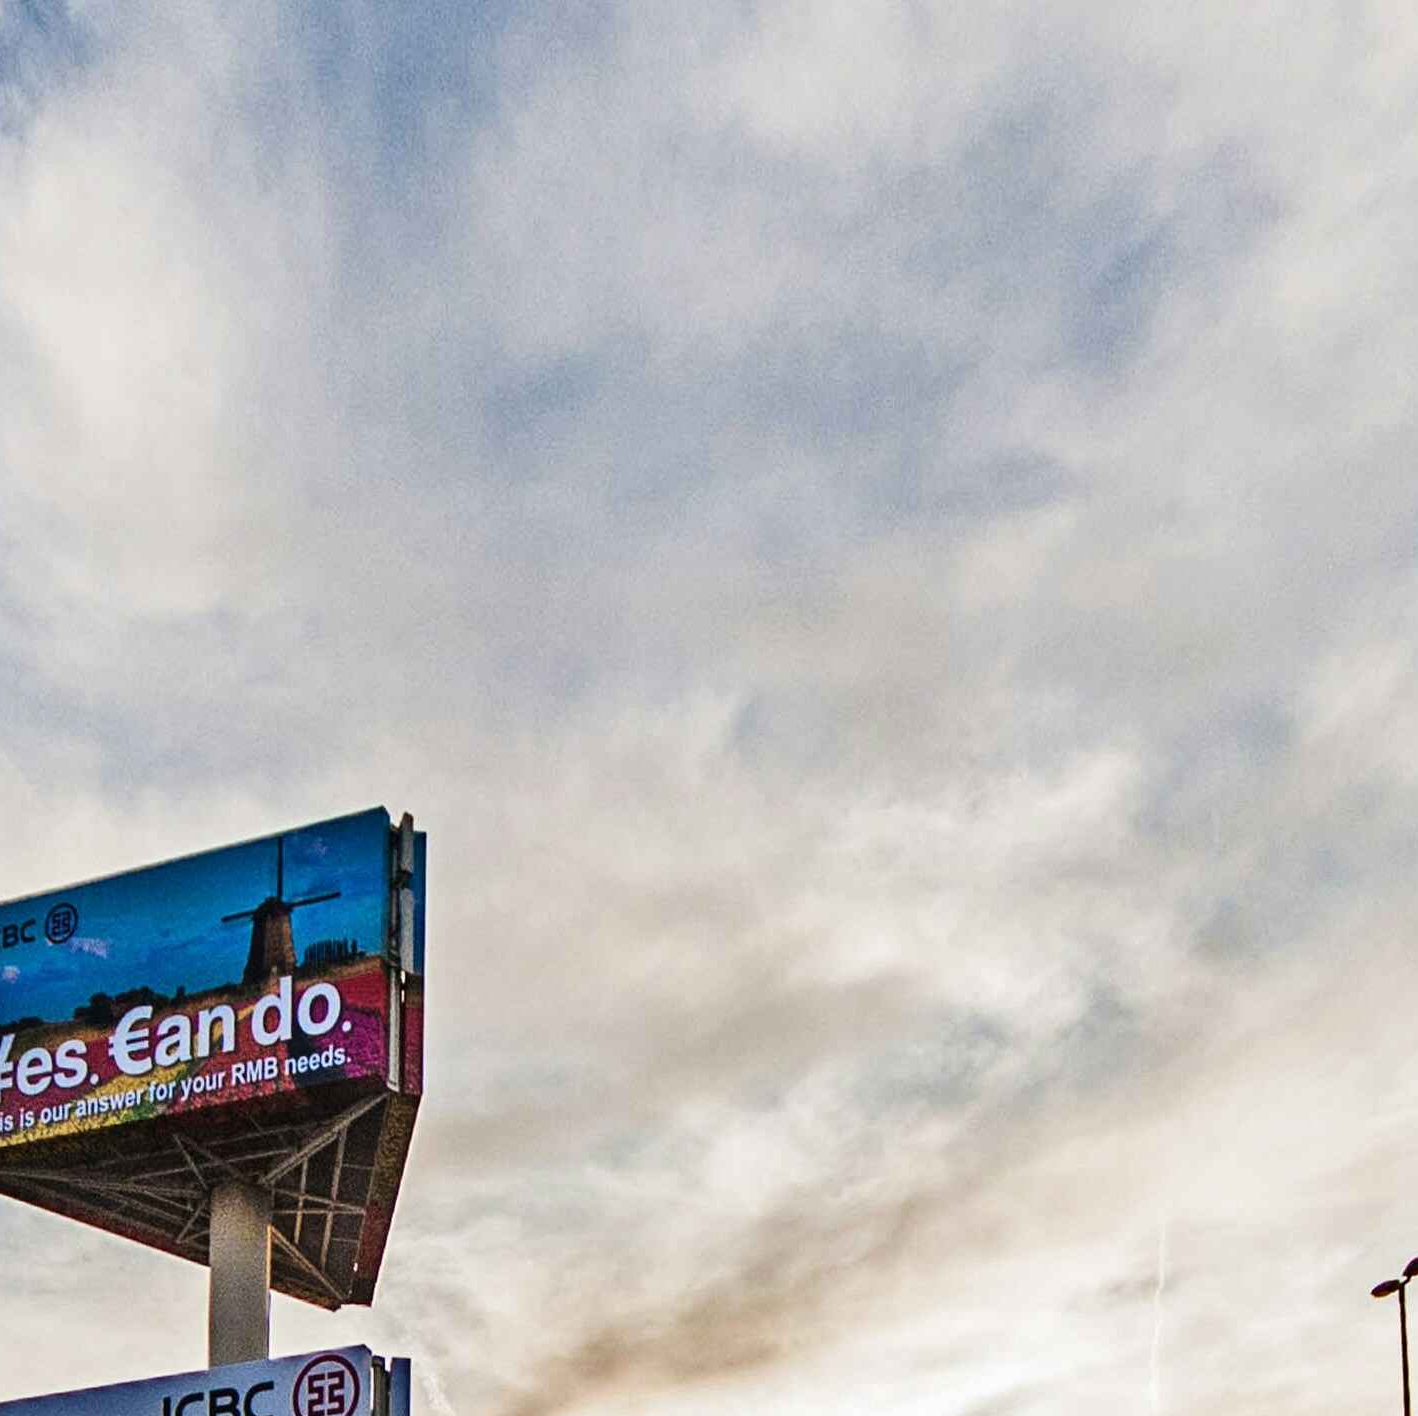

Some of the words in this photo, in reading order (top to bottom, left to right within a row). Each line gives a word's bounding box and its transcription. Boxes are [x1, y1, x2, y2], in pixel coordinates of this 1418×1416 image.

[108, 1003, 237, 1076] €an
[250, 975, 352, 1047] do.
[19, 1107, 36, 1130] is
[39, 1102, 72, 1125] our
[75, 1086, 145, 1117] answer
[147, 1080, 177, 1103] for
[180, 1071, 227, 1102] your
[230, 1056, 279, 1087] RMB
[284, 1044, 352, 1076] needs.
